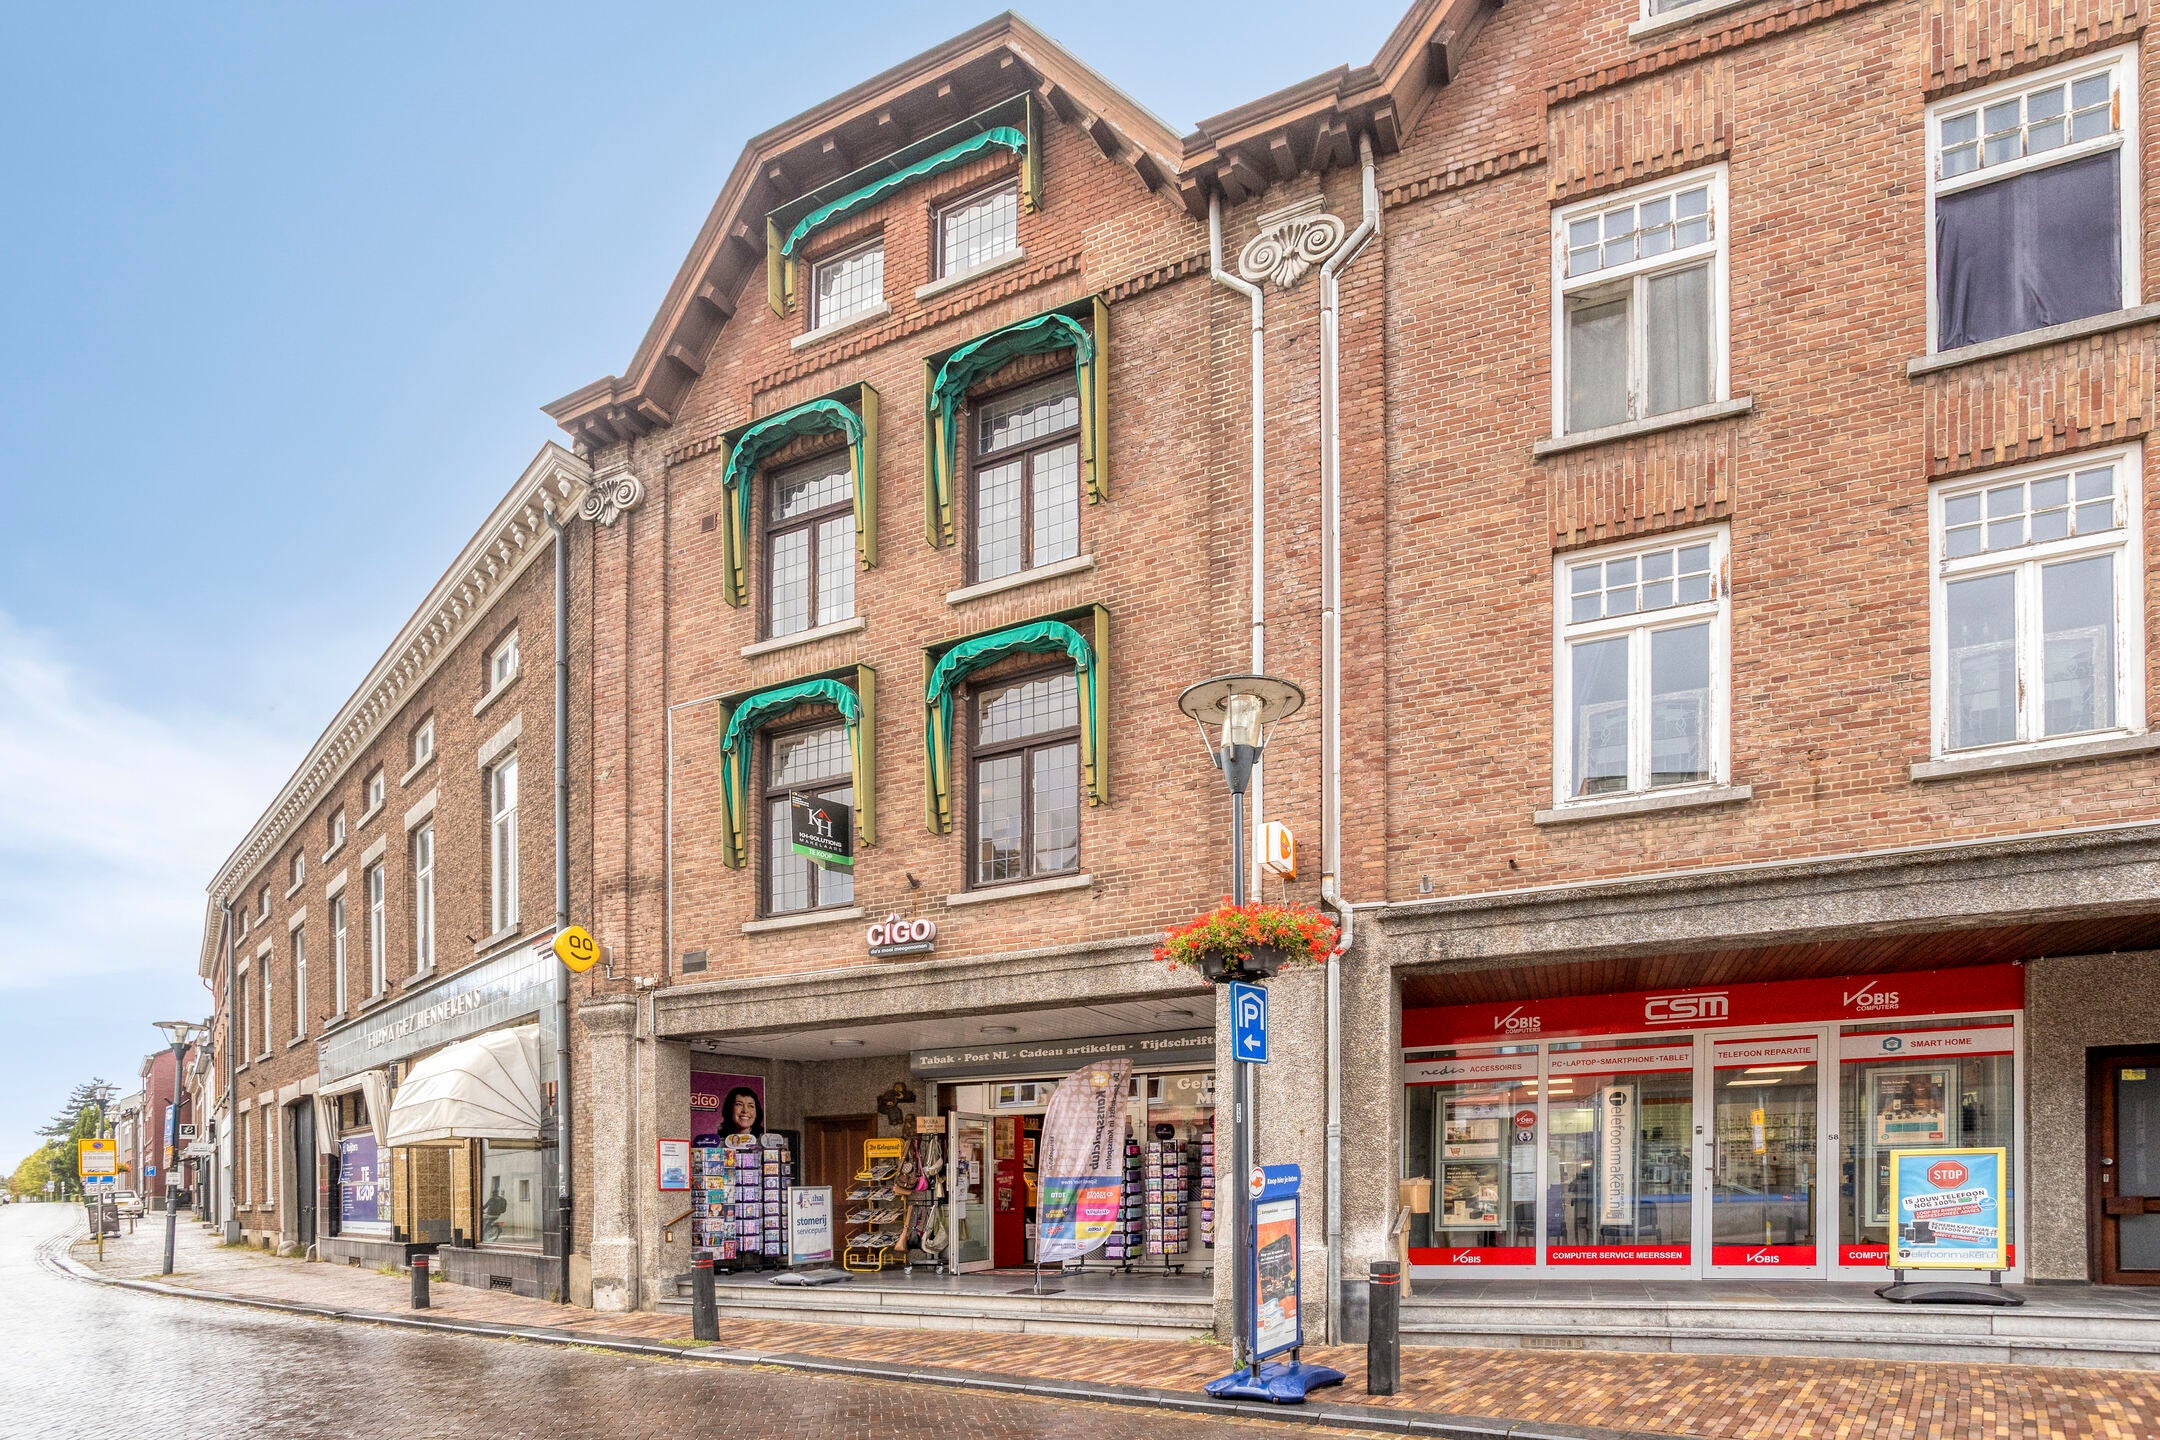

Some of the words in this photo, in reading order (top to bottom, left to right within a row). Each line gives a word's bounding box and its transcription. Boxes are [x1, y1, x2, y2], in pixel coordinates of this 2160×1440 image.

[1844, 980, 1900, 1007] VOBIS
[1645, 996, 1729, 1020] CSM
[1856, 1003, 1900, 1012] COMPUTERS
[1244, 1003, 1259, 1028] P
[1494, 1006, 1542, 1030] VOBIS
[1505, 1027, 1542, 1035] COMPUTERS
[1910, 1039, 1943, 1048] SMART
[1944, 1037, 1973, 1046] HOME
[919, 1054, 955, 1065] Tabak
[964, 1052, 990, 1063] Post
[993, 1051, 1010, 1061] NL
[1019, 1046, 1064, 1058] Cadeau
[1066, 1042, 1126, 1056] artikelen
[1718, 1050, 1762, 1059] TELEFOON
[1764, 1046, 1811, 1056] REPARATIE
[1469, 1063, 1522, 1073] ACCESSOIRES
[361, 1166, 370, 1182] TE
[1933, 1169, 1963, 1180] STOP
[1916, 1195, 1940, 1204] JOUW
[1941, 1189, 1985, 1200] TELEFOON
[796, 1213, 827, 1227] stomerij
[796, 1227, 828, 1236] servicepunt
[1453, 1249, 1481, 1264] VOBIS
[1599, 1251, 1635, 1259] SERVICE
[1636, 1251, 1683, 1259] MEERSSEN
[1747, 1248, 1780, 1263] VOBIS
